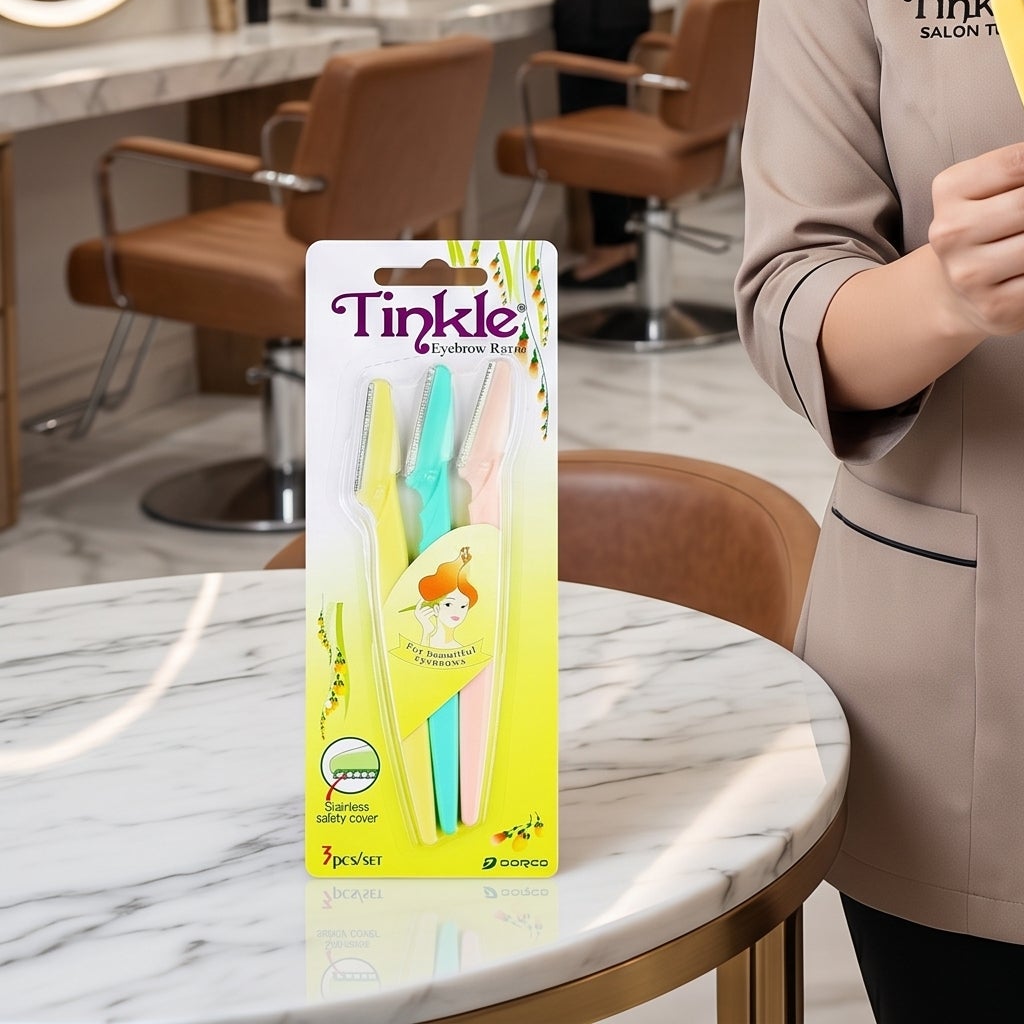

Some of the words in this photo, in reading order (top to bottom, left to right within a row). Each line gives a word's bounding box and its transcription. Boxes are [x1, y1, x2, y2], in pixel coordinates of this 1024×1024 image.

[920, 24, 979, 39] SALON
[331, 289, 519, 355] Tinkle
[431, 342, 486, 357] Eyebrow
[406, 642, 423, 655] For
[316, 812, 347, 825] safety
[349, 814, 379, 824] cover
